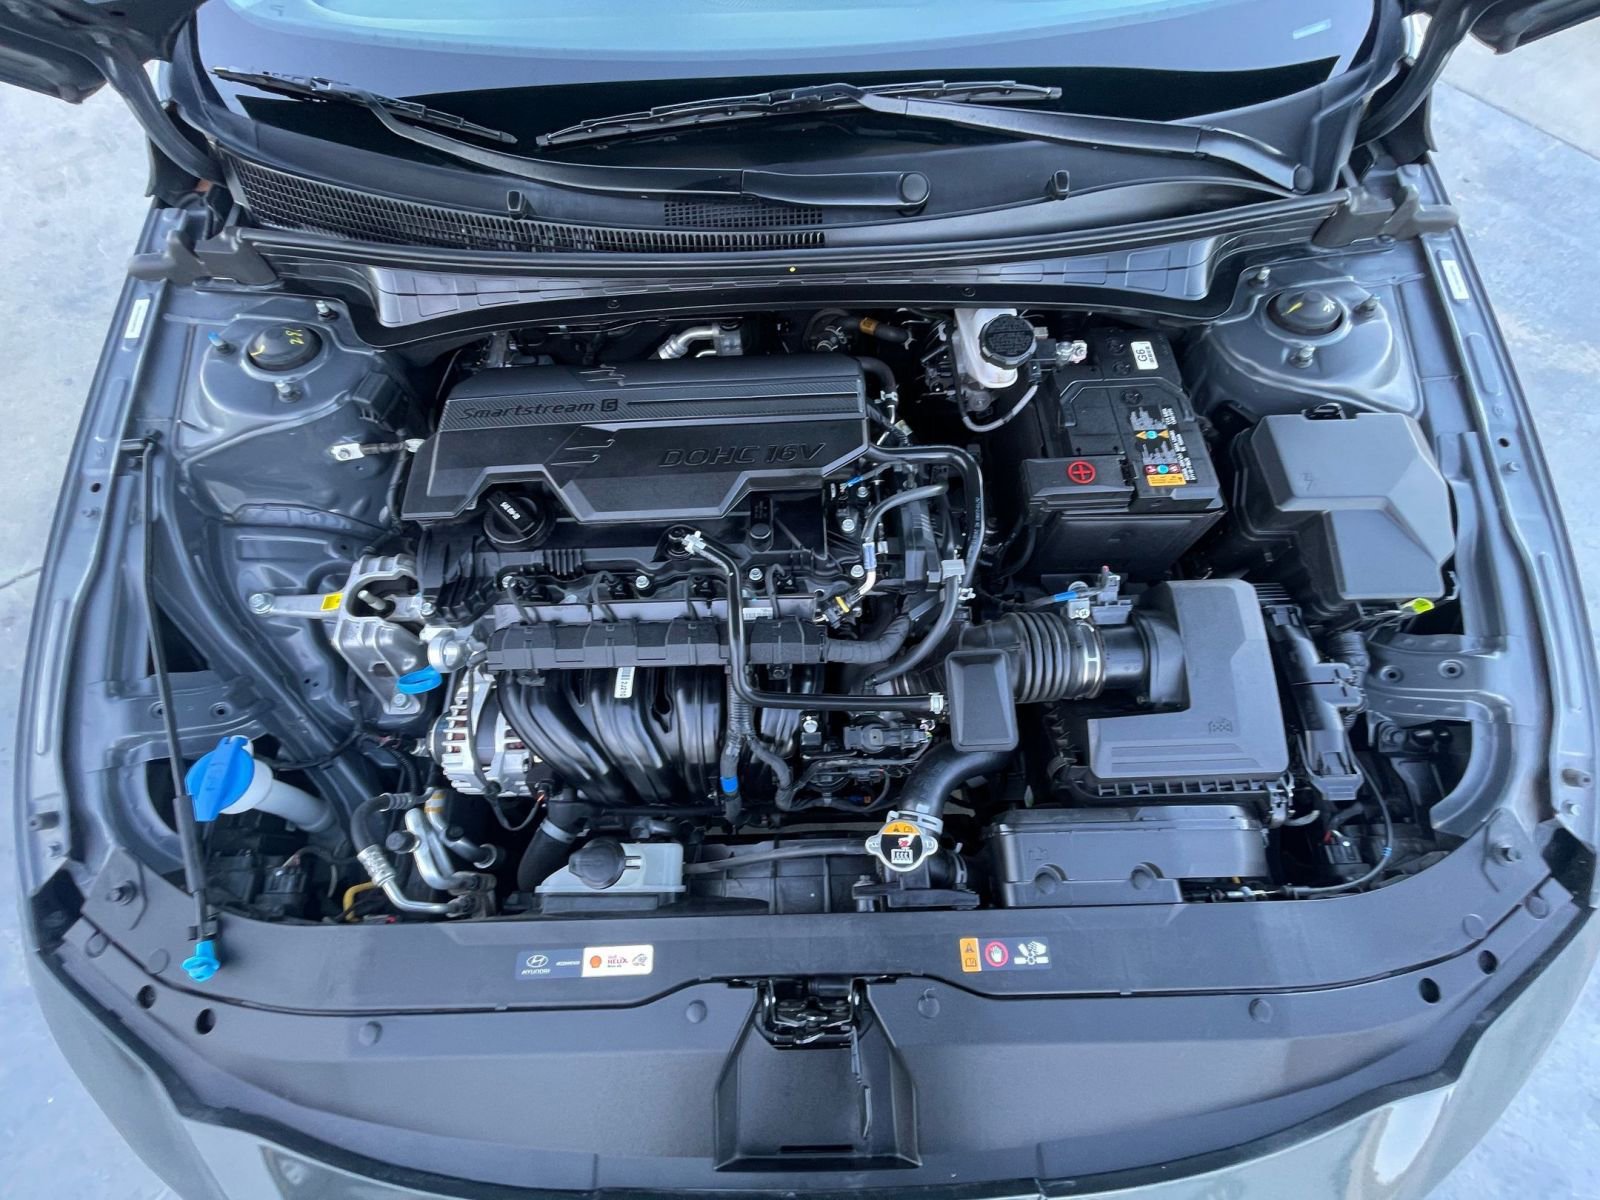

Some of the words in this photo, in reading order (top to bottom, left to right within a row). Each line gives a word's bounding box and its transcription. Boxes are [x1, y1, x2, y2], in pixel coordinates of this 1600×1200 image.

[460, 402, 595, 420] Smartstream
[658, 445, 761, 467] DOHC
[765, 442, 826, 463] 16V
